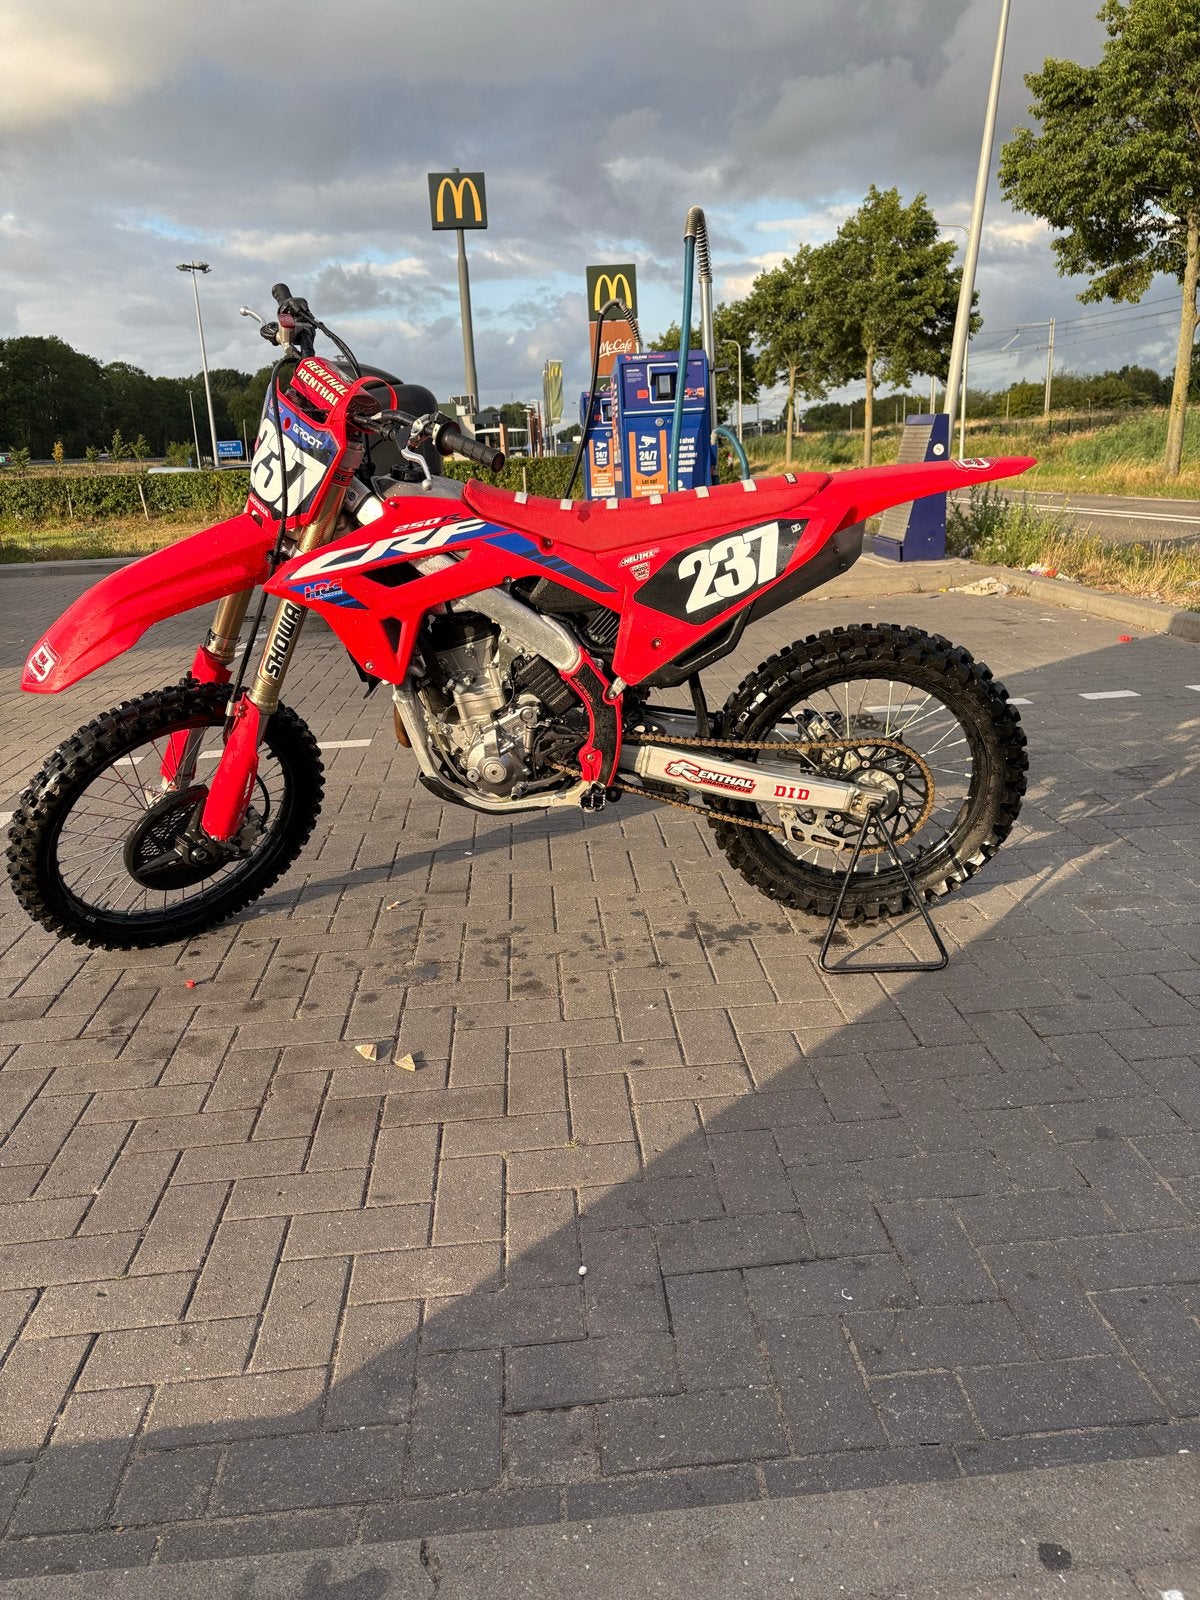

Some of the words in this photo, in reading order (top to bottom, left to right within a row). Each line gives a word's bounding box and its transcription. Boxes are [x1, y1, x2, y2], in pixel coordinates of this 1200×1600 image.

[304, 361, 349, 395] RENTHAL
[293, 423, 323, 449] GROOT
[639, 450, 658, 461] 24/7
[392, 513, 463, 534] 250R
[290, 517, 487, 580] CRF
[678, 521, 780, 614] 237
[304, 578, 343, 602] HRC
[265, 602, 302, 680] SHOWA
